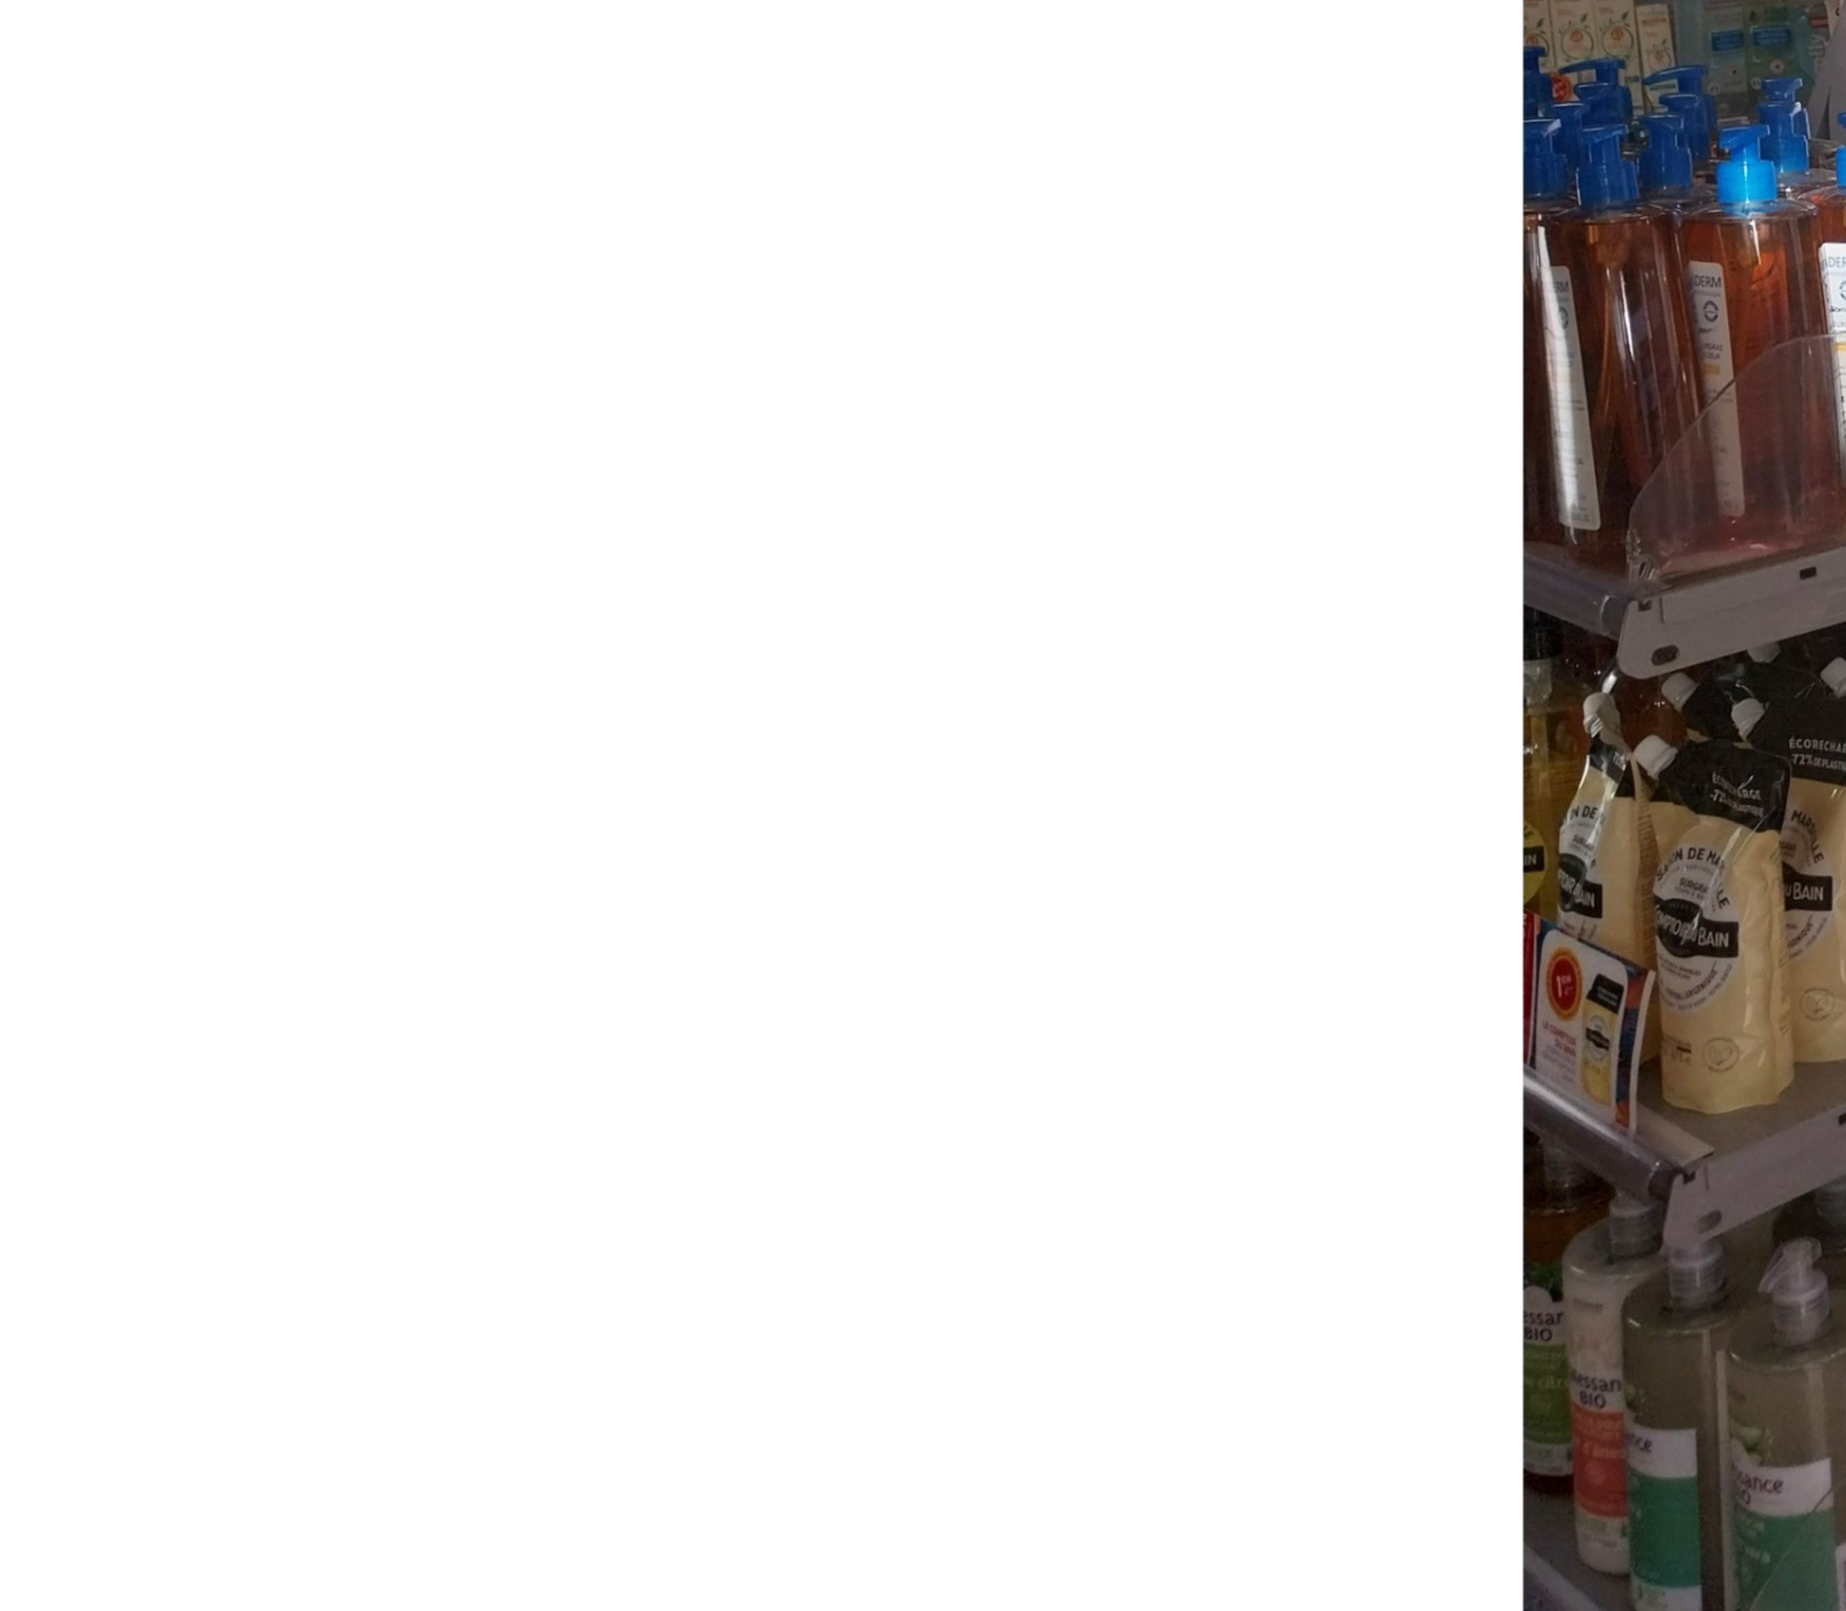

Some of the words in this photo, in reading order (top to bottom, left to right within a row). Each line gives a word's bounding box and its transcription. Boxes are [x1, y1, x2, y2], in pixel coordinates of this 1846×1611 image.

[1581, 805, 1597, 819] DE
[1687, 847, 1704, 861] DE
[1792, 883, 1824, 901] BAIN
[1699, 926, 1730, 948] BAIN
[1524, 1326, 1552, 1342] BIO
[1579, 1390, 1607, 1409] BIO
